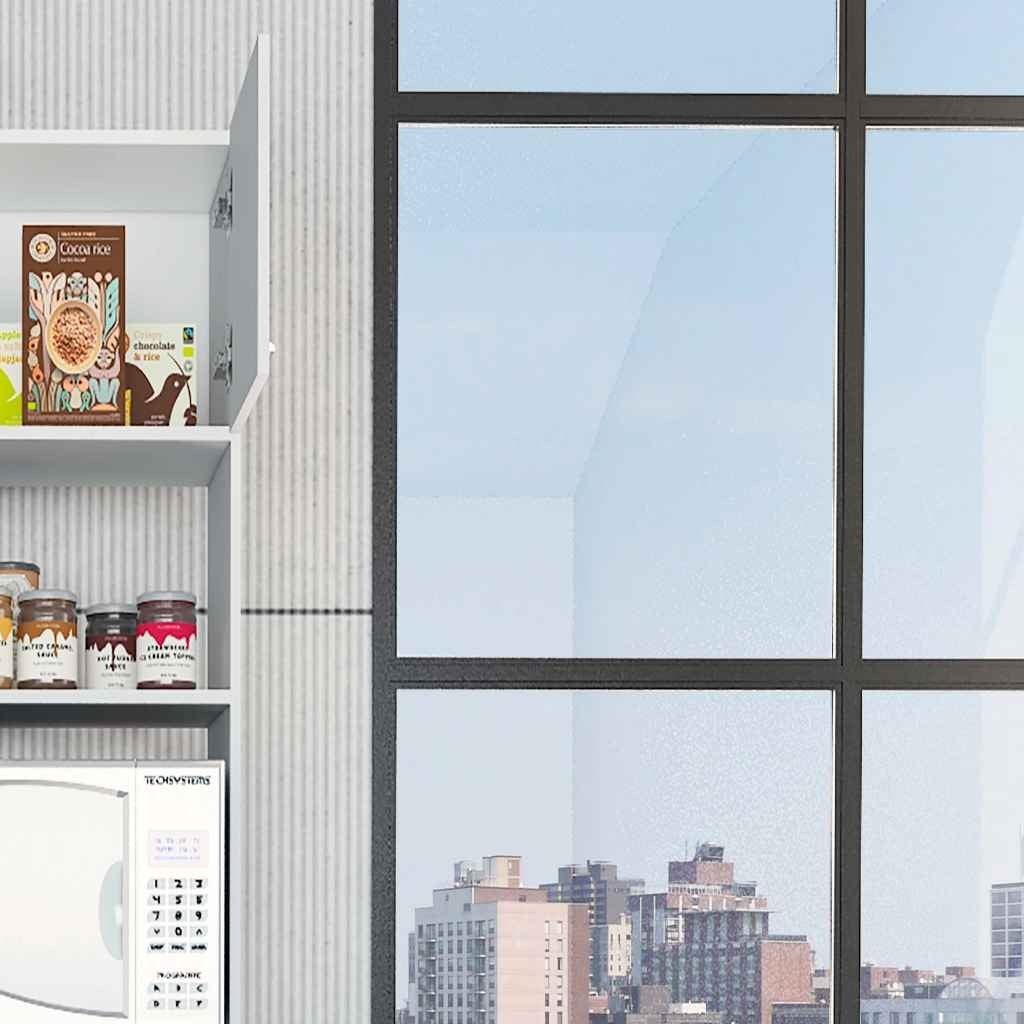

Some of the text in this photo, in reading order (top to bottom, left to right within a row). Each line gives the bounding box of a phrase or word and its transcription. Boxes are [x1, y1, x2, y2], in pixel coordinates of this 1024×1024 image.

[60, 242, 112, 256] Cocoa rice
[134, 341, 176, 351] chocolate
[133, 353, 161, 361] & rice
[174, 879, 183, 889] 2
[195, 879, 203, 889] 3
[152, 895, 161, 905] 4
[175, 895, 183, 905] 5
[152, 910, 202, 921] 7 8 9
